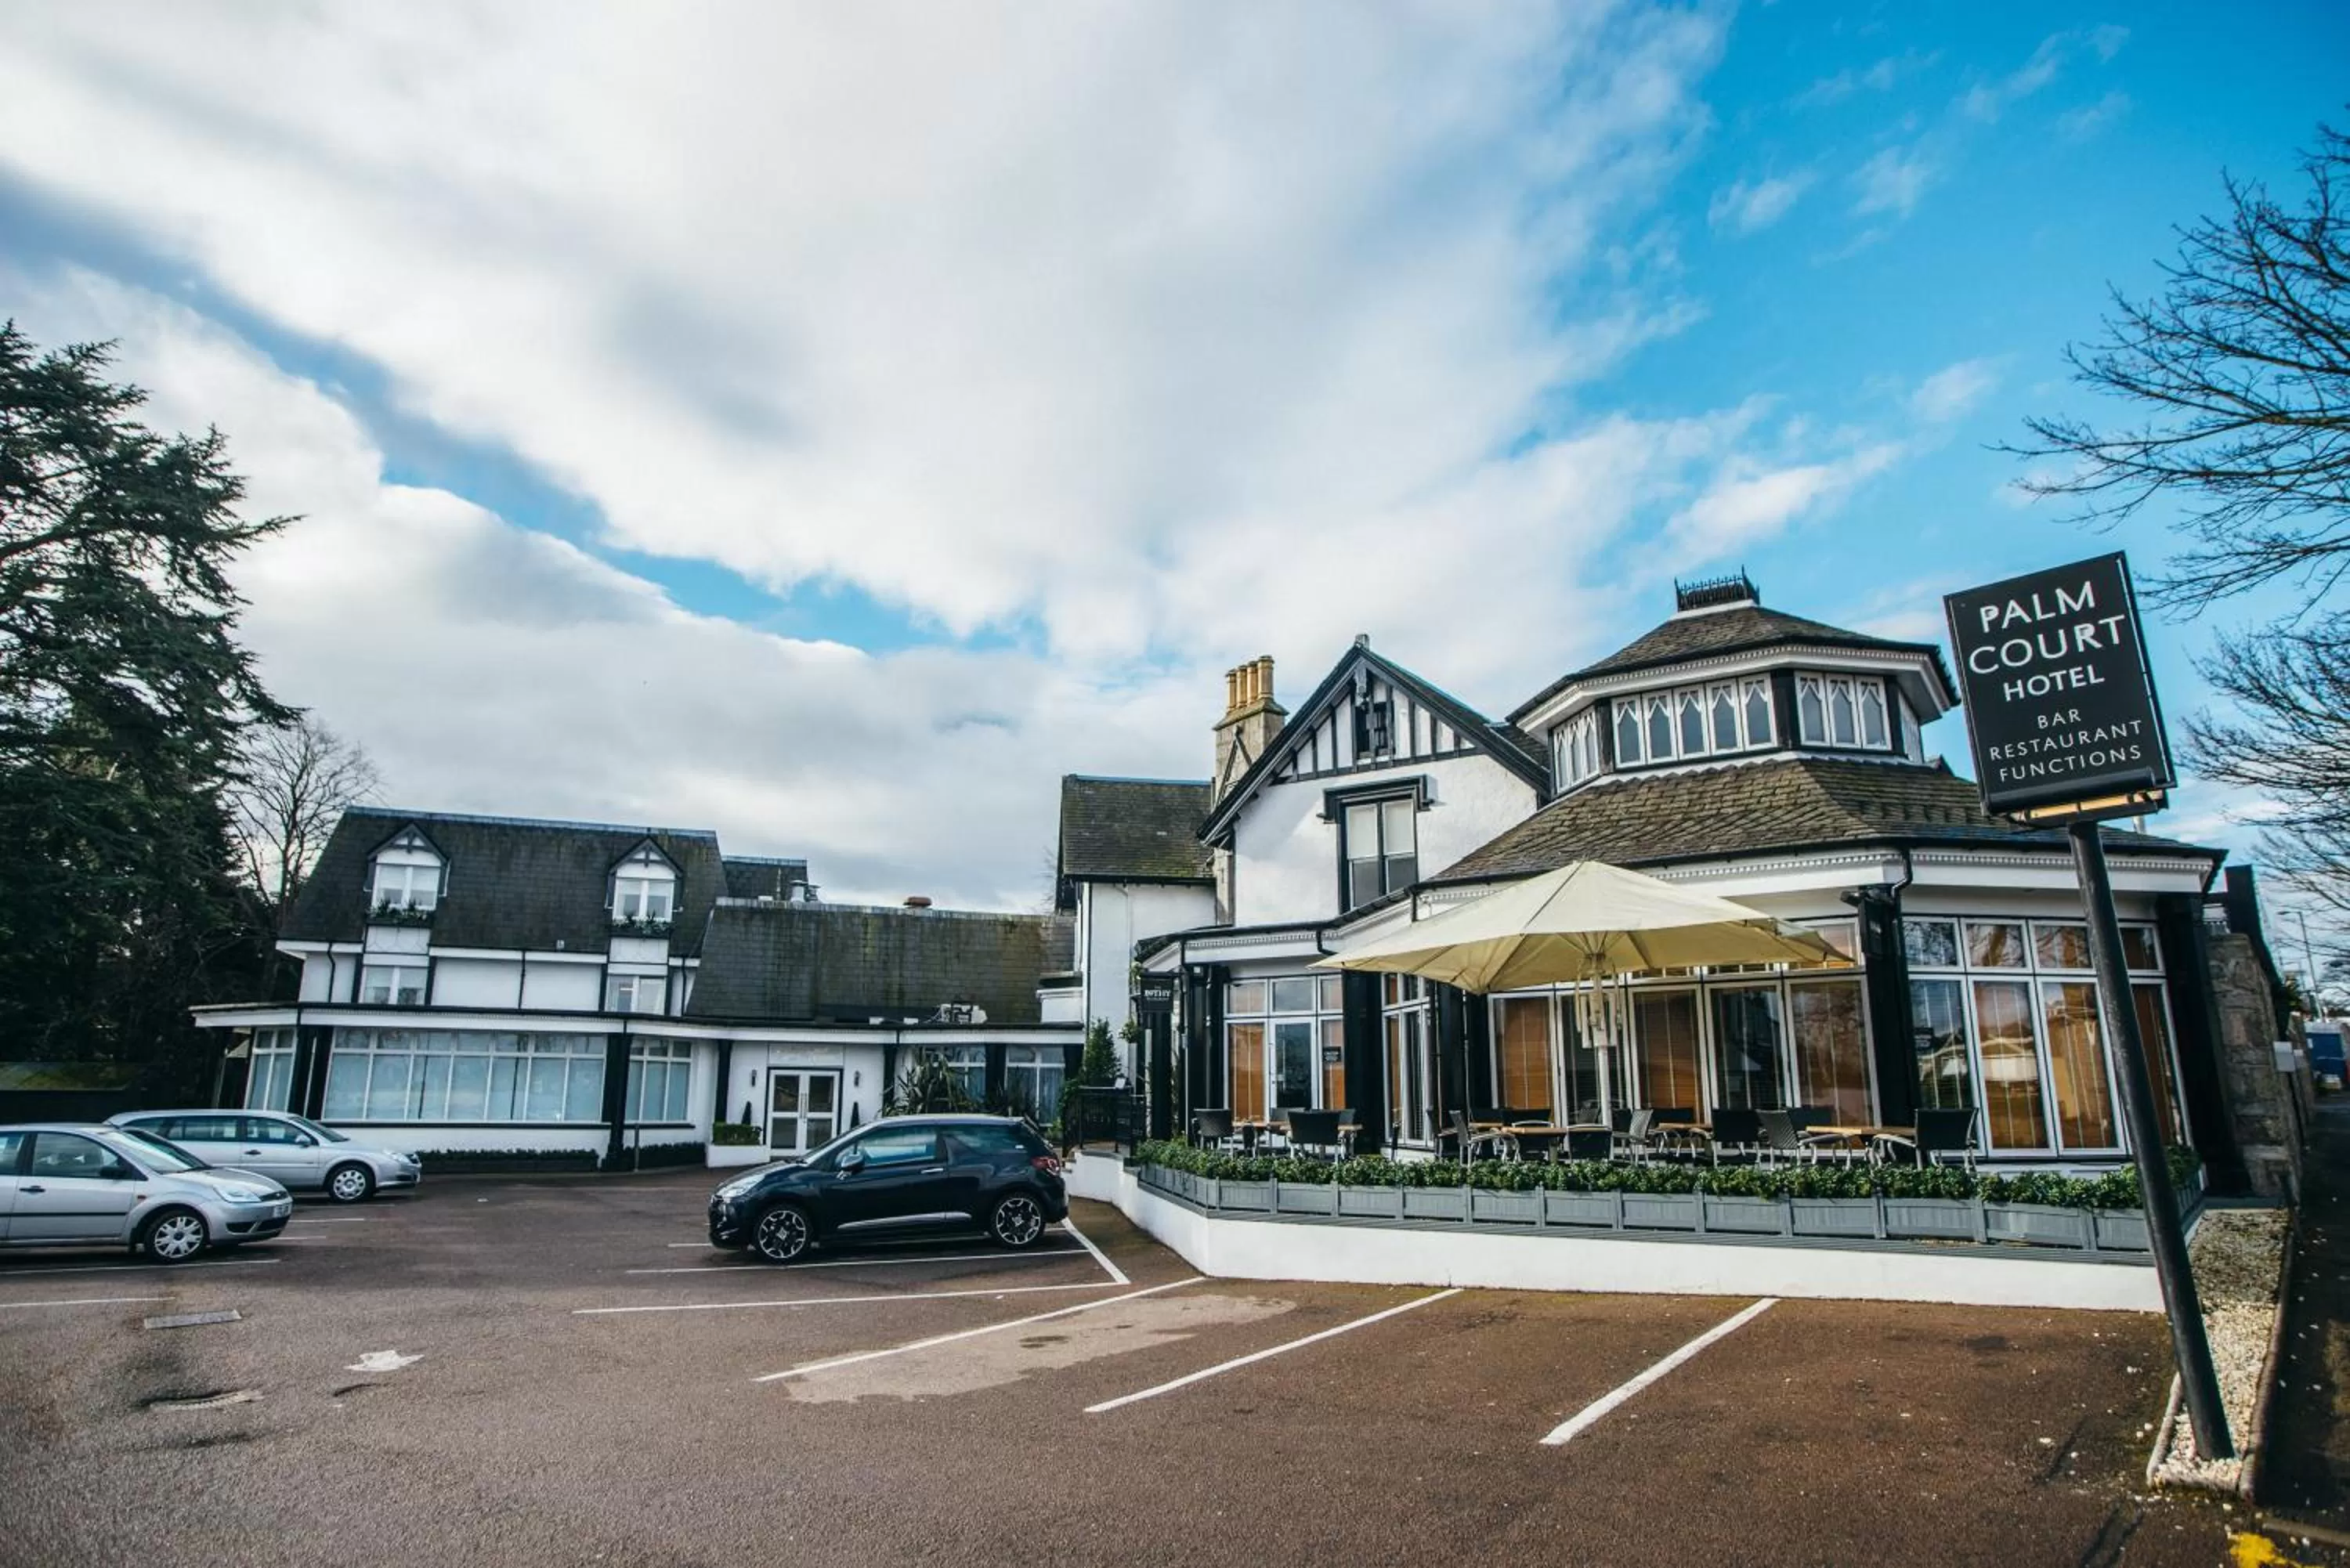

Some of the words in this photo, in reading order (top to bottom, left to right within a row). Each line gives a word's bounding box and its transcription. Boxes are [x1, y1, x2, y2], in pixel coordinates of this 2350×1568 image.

[1980, 580, 2095, 633] PALM
[1969, 615, 2124, 674] COURT
[2003, 665, 2106, 702] HOTEL
[2037, 709, 2081, 729] BAR
[1990, 720, 2142, 761] RESTAURANT
[1999, 745, 2142, 782] FUNCTIONS
